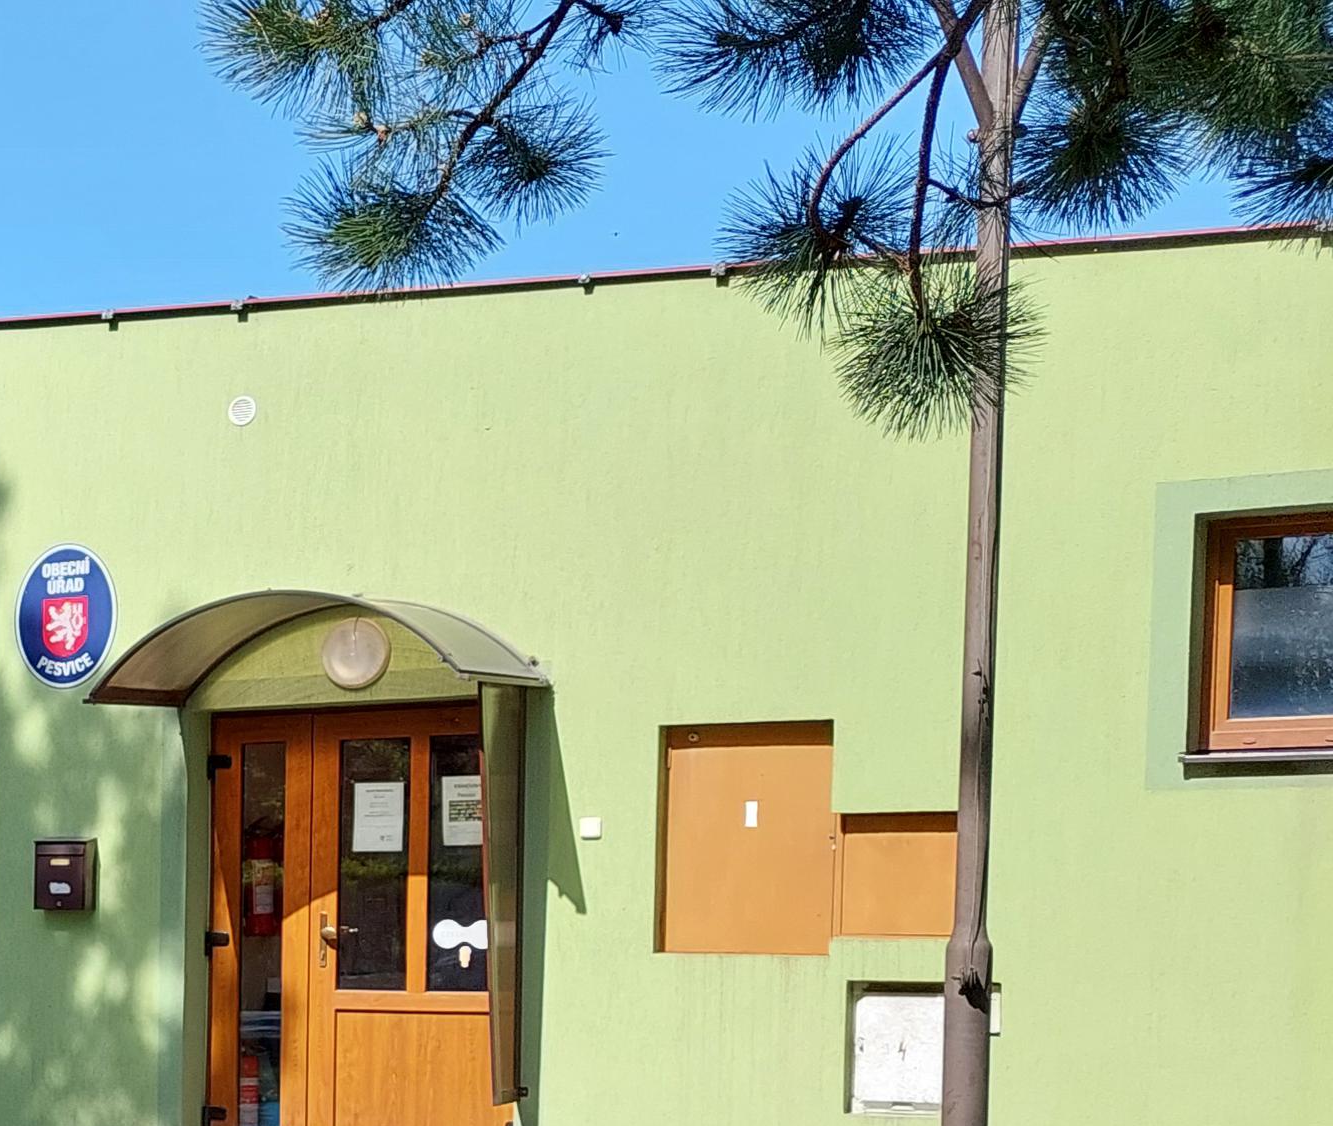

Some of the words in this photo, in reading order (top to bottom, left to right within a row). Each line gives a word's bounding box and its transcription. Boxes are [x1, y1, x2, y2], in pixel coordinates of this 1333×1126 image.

[41, 557, 90, 578] OBECNÍ
[46, 577, 84, 594] ÚŘAD
[36, 652, 94, 677] PESVICE
